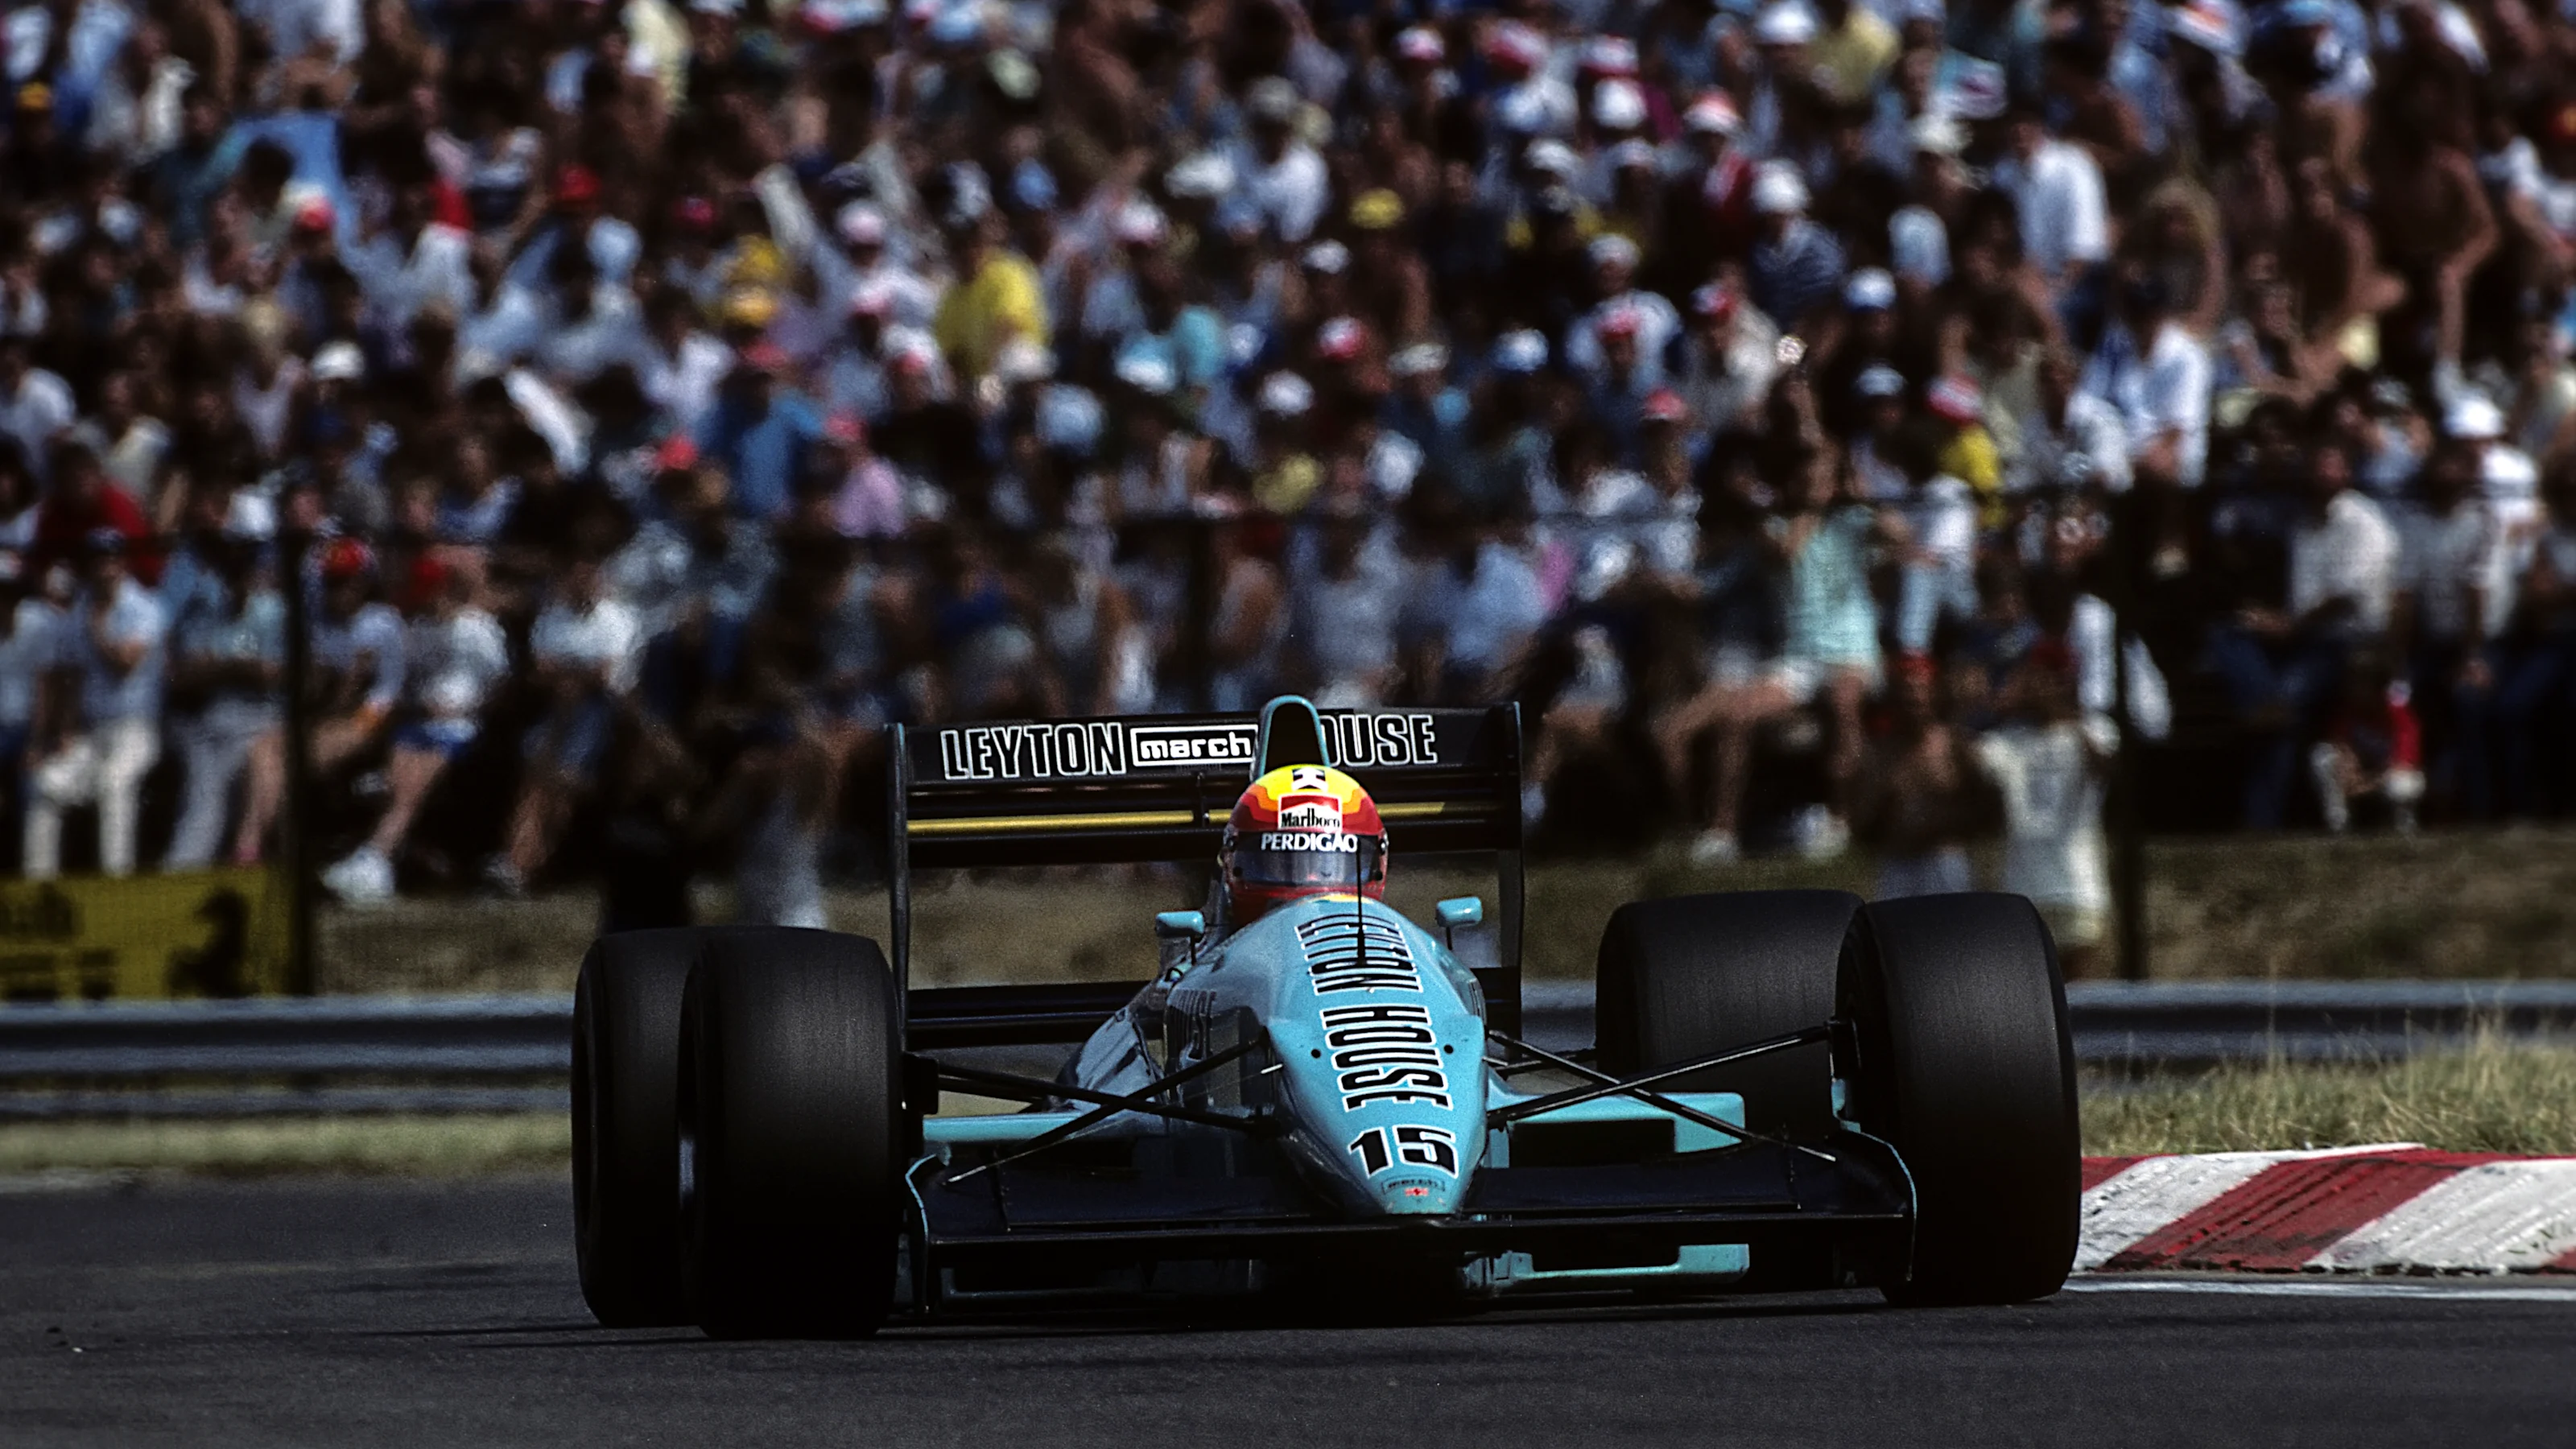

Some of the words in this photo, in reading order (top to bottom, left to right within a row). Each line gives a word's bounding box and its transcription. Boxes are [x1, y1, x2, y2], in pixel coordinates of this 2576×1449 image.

[940, 722, 1127, 780] LEYTON
[1139, 730, 1251, 759] march
[1280, 807, 1340, 828] Marlboro
[1294, 914, 1423, 995] LEYTON
[1319, 1005, 1453, 1113] HOUSE
[1348, 1124, 1459, 1179] 15
